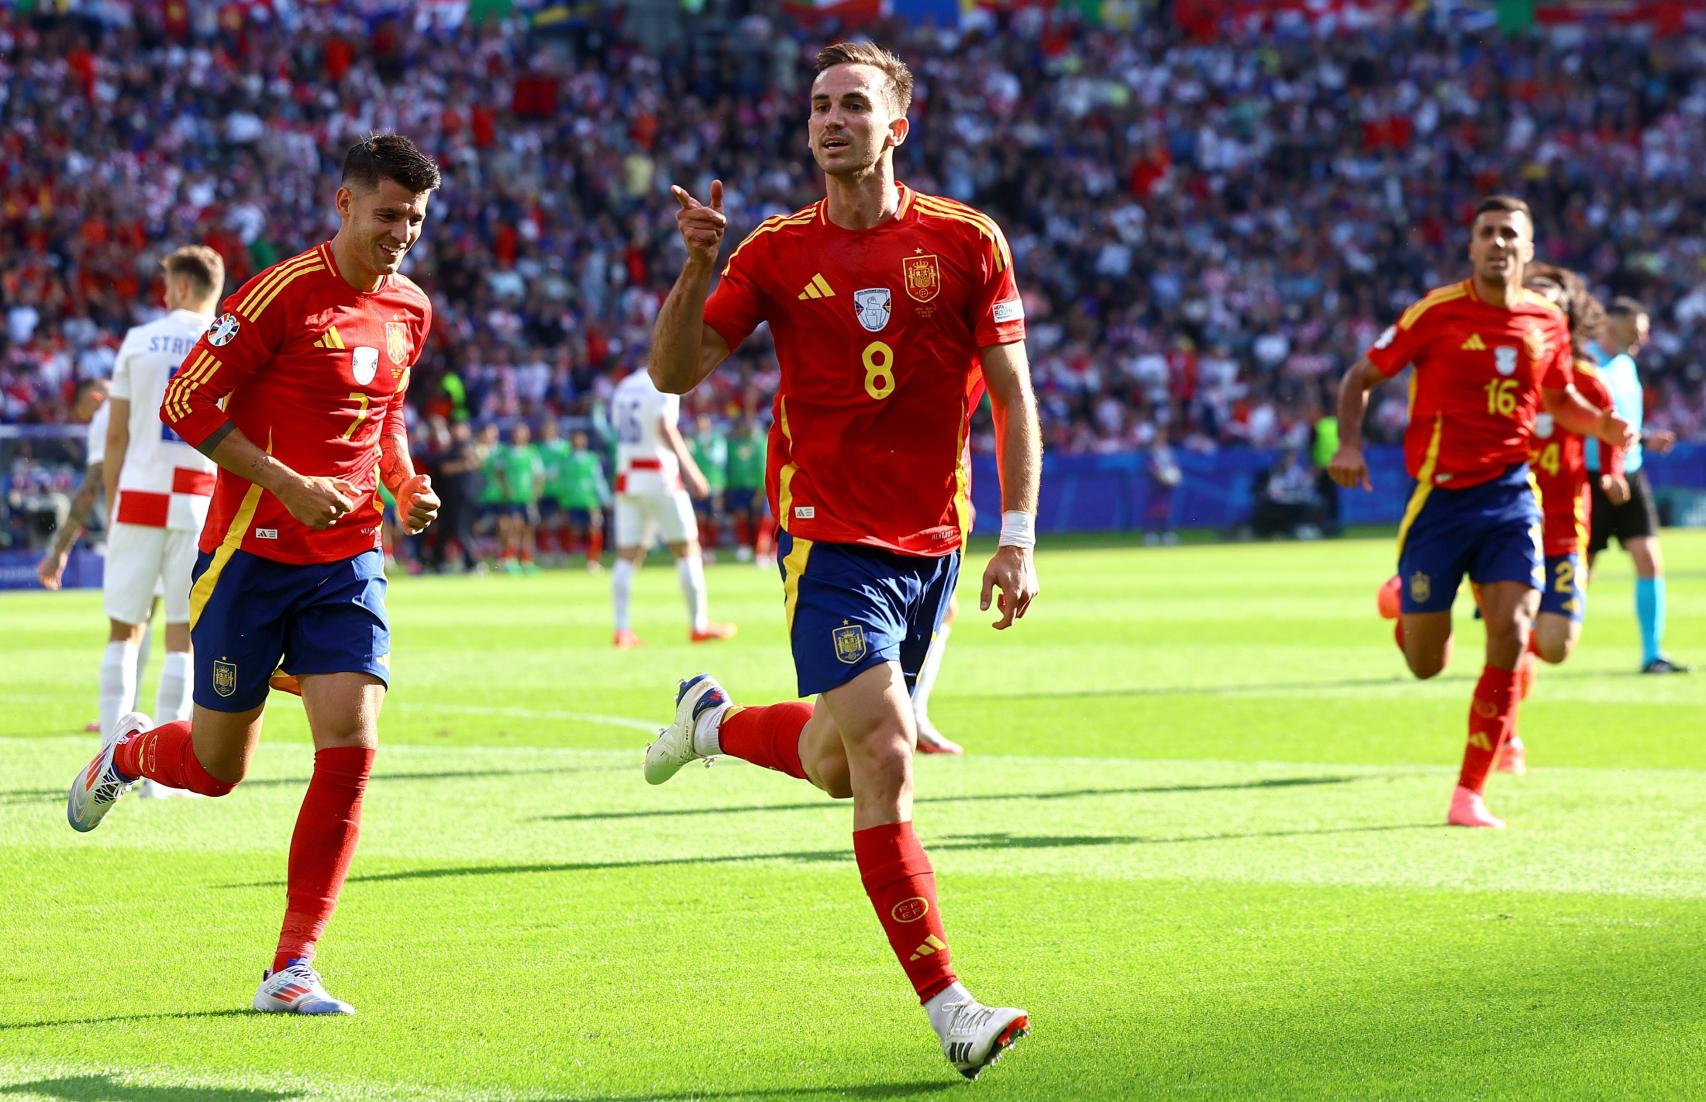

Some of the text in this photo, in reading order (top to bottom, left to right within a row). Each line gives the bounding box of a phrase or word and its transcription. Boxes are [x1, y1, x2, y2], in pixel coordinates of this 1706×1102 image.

[862, 341, 895, 400] 8
[342, 392, 369, 441] 7
[1484, 378, 1518, 415] 16
